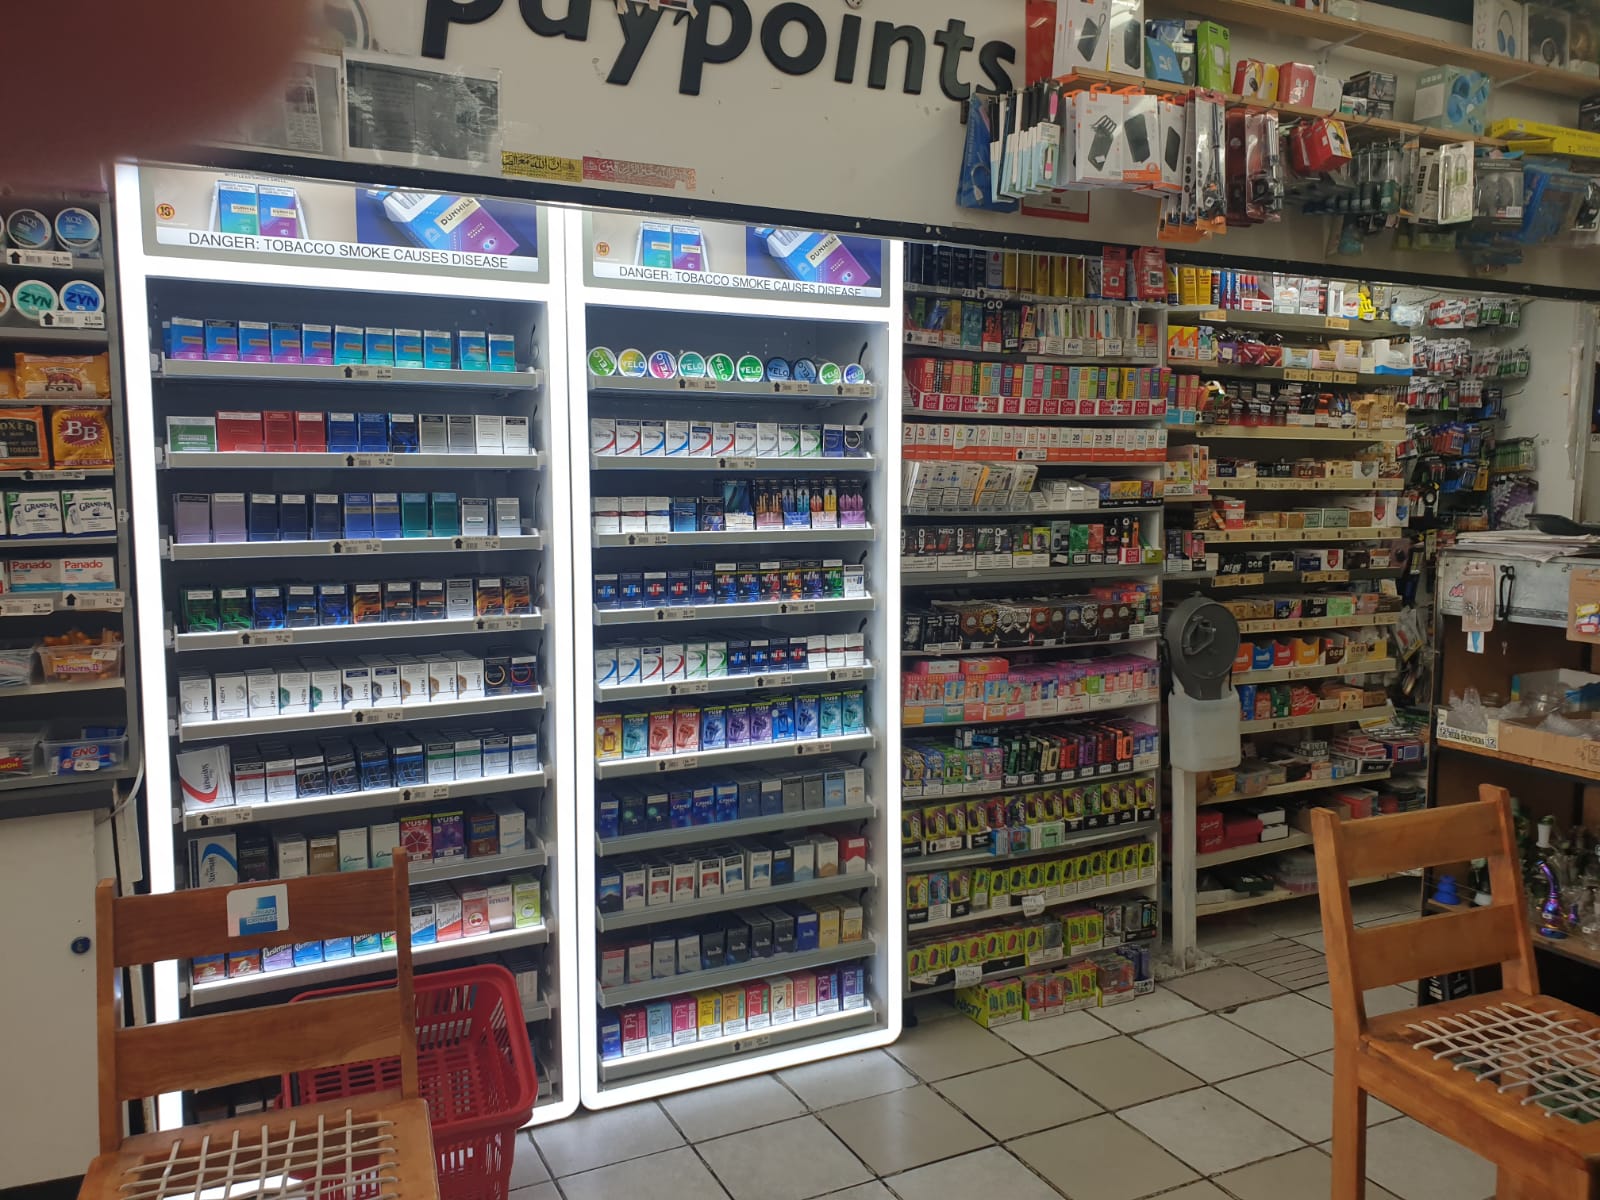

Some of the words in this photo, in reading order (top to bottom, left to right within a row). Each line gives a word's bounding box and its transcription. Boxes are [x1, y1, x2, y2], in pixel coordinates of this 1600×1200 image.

[440, 198, 474, 226] DUNHILL
[189, 232, 261, 251] DANGER:
[265, 239, 336, 256] TOBACCO
[340, 244, 391, 260] SMOKE
[394, 247, 449, 264] CAUSES
[452, 253, 509, 269] DISEASE
[810, 236, 837, 262] DUNHILL
[619, 265, 673, 282] DANGER:
[675, 270, 729, 287] TOBACCO
[732, 275, 771, 290] SMOKE
[773, 280, 816, 295] CAUSES
[817, 285, 862, 298] DISEASE
[18, 291, 52, 309] ZYN
[65, 291, 99, 307] ZYN
[680, 362, 704, 371] VELO
[739, 366, 761, 374] VELO
[768, 367, 789, 377] VELO
[64, 420, 98, 441] BB
[905, 427, 912, 436] 2
[918, 427, 925, 437] 3
[930, 428, 936, 436] 4
[944, 428, 950, 437] 5
[956, 428, 963, 437] 6
[967, 428, 974, 438] 7
[24, 502, 59, 513] GRAND-PA
[79, 501, 113, 512] GRAND-PA
[12, 561, 52, 570] Panado
[64, 560, 104, 569] Panado
[72, 745, 98, 758] ENO
